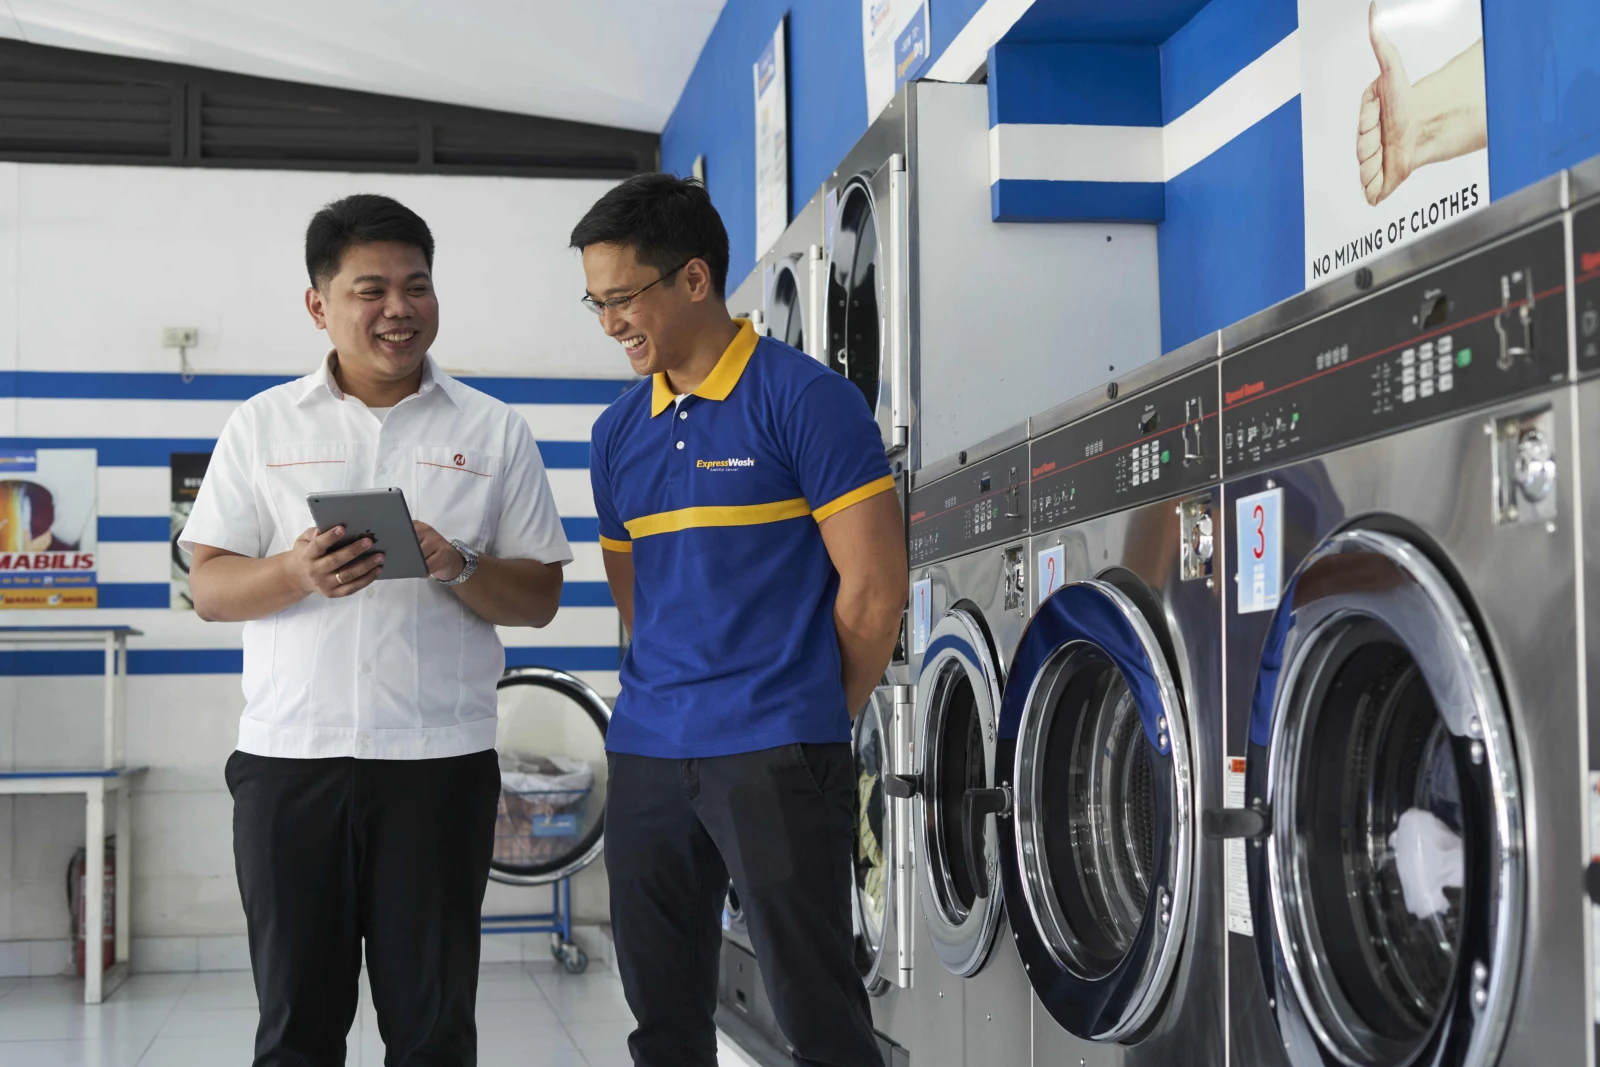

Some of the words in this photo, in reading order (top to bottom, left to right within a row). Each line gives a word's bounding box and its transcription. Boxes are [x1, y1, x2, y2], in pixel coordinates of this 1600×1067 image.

[1313, 254, 1331, 279] NO
[1335, 229, 1383, 269] MIXING
[1387, 216, 1406, 243] OF
[1411, 183, 1479, 232] CLOTHES
[696, 457, 754, 469] ExpressWash
[1253, 504, 1265, 559] 3
[920, 587, 925, 620] 1
